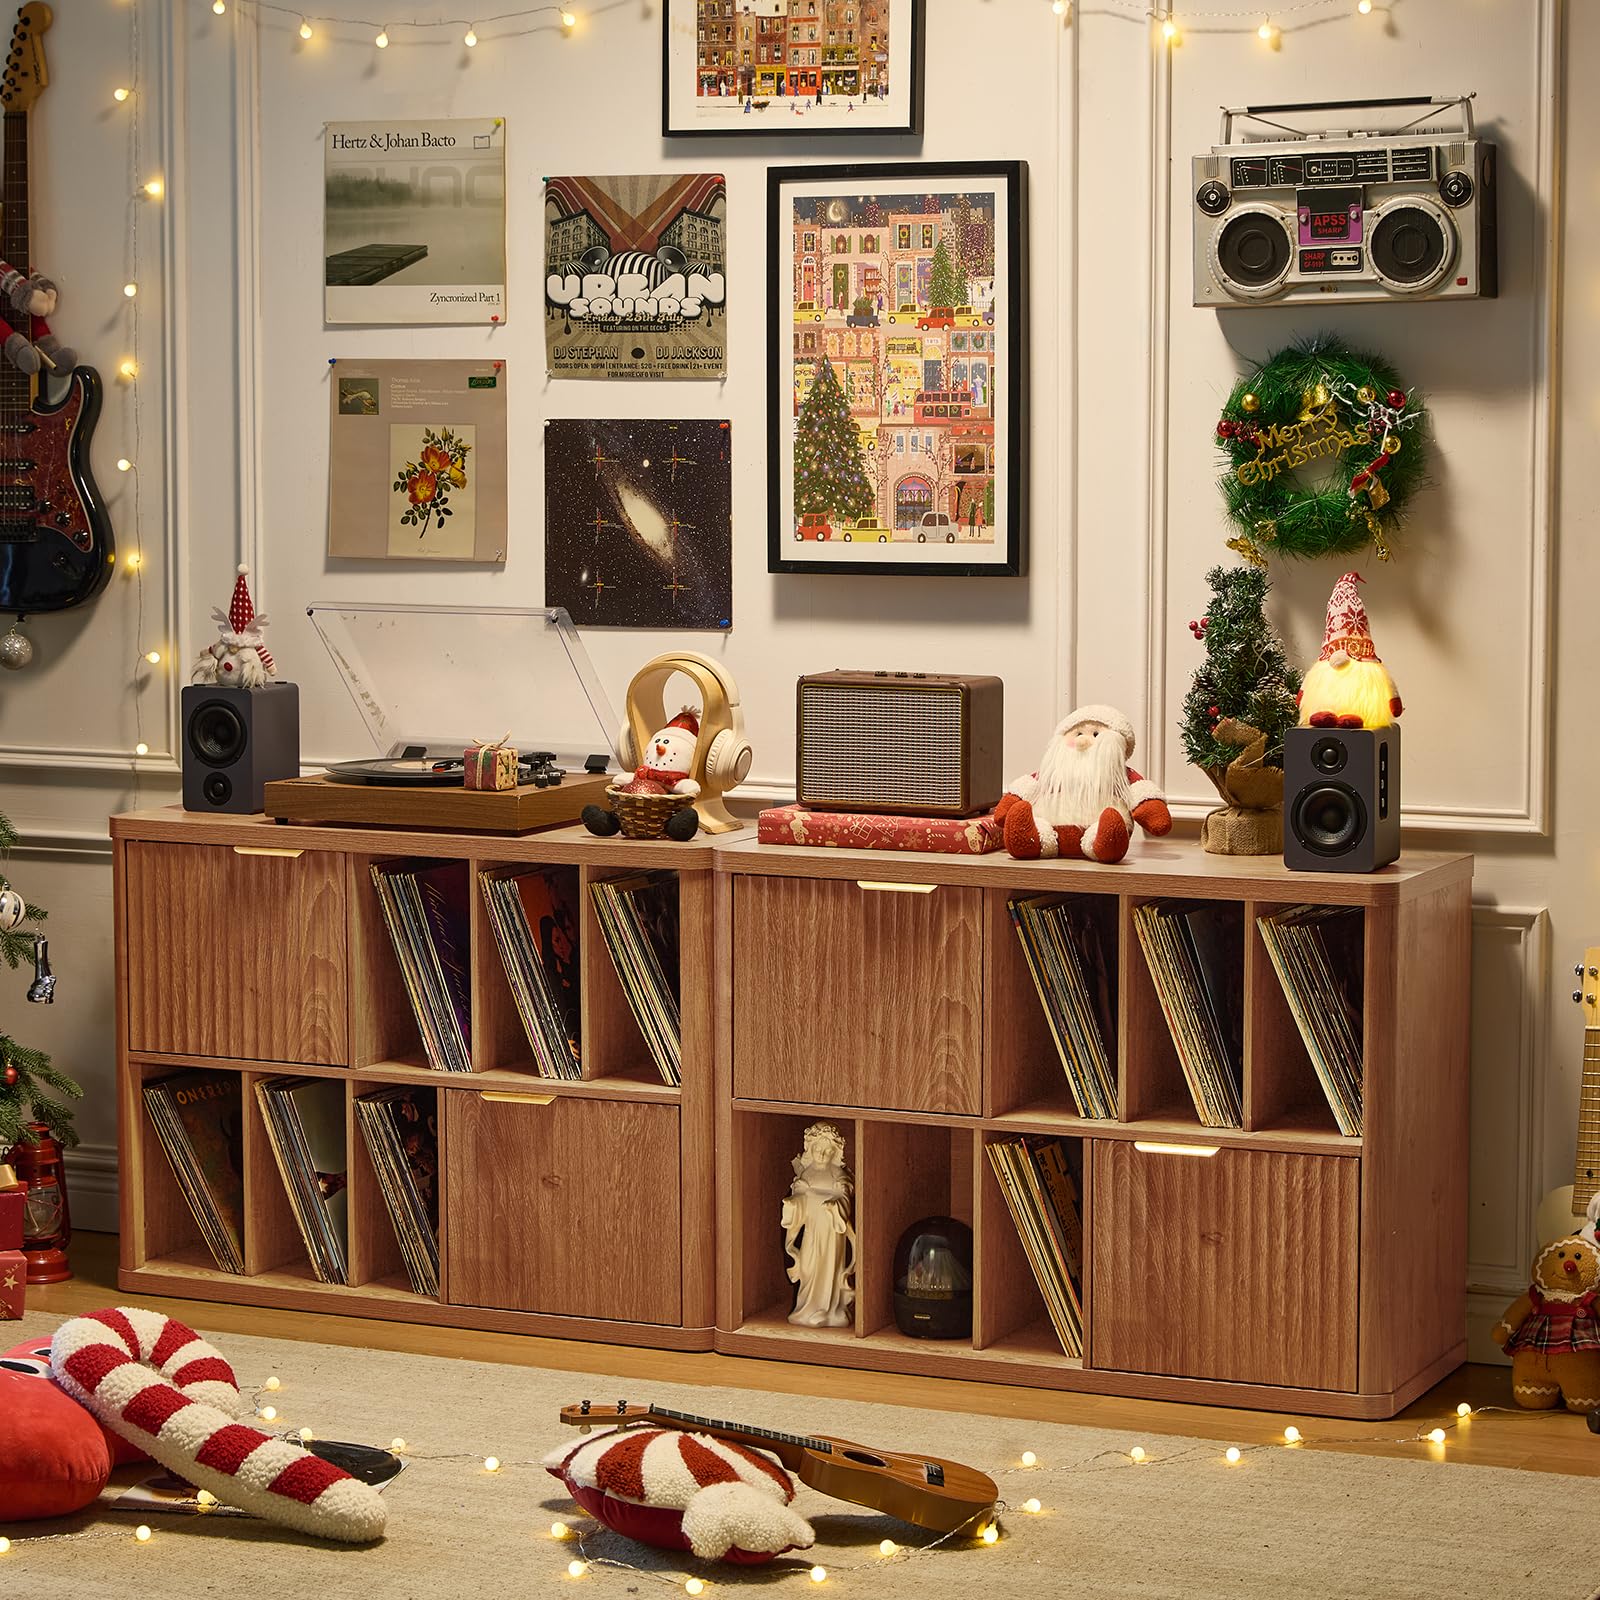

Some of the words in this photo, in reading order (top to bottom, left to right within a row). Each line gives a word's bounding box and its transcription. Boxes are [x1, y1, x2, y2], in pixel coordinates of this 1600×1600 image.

[332, 134, 367, 149] Hertz
[369, 134, 384, 148] &
[384, 132, 419, 151] Johan
[421, 131, 456, 148] Bacto
[1313, 215, 1346, 226] APSS
[1304, 252, 1326, 260] SHARP
[546, 272, 726, 304] URBAN
[430, 292, 476, 305] Zyncronized
[479, 292, 494, 302] Part
[496, 292, 500, 302] 1
[569, 297, 702, 317] SOUNDS
[583, 311, 621, 325] Friday
[657, 312, 686, 325] July
[554, 346, 567, 359] DJ
[568, 346, 619, 360] STEPHAN
[655, 346, 669, 359] DJ
[670, 346, 723, 360] JACKSON
[1253, 413, 1338, 456] Merry
[1238, 423, 1371, 485] Christmas
